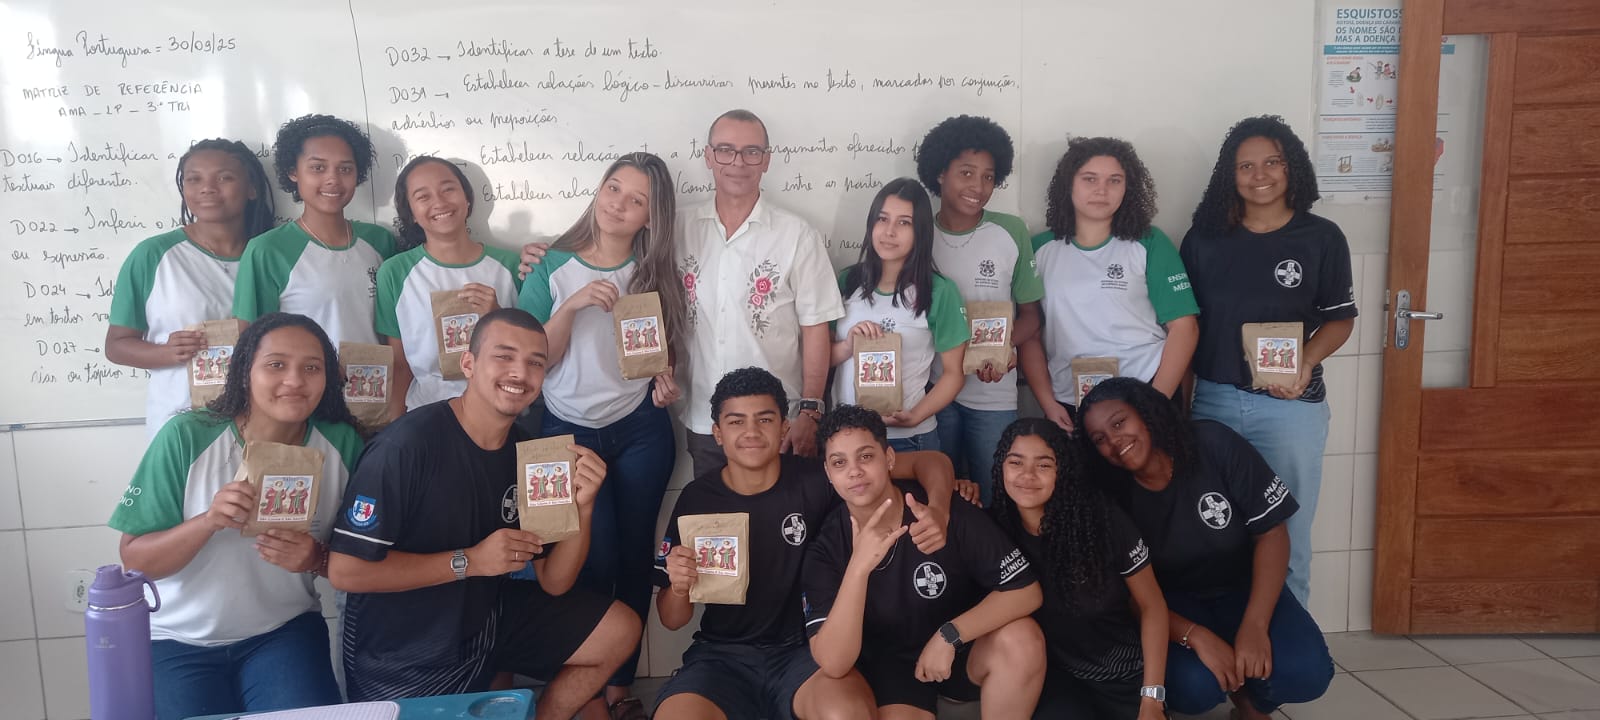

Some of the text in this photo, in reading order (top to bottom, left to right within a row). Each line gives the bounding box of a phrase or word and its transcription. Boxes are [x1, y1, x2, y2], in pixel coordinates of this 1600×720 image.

[1335, 26, 1347, 34] OS
[1349, 26, 1377, 34] NOMES
[1379, 25, 1396, 34] SÃO
[1335, 34, 1353, 42] MAS
[1354, 34, 1361, 42] A
[1363, 34, 1396, 43] DOENÇA
[76, 30, 153, 68] Portuguesa
[457, 37, 534, 63] Identificar
[542, 47, 550, 57] a
[554, 37, 576, 57] tese
[584, 40, 597, 57] de
[601, 47, 622, 57] um
[463, 69, 531, 92] Estabelecer
[748, 72, 797, 95] presentes
[803, 80, 820, 89] no
[938, 73, 956, 89] por
[22, 85, 69, 101] MATRIZ
[84, 84, 101, 97] DE
[58, 106, 88, 117] AMA
[465, 116, 483, 126] ou
[0, 149, 43, 167] D016
[68, 141, 159, 167] Identificar
[480, 141, 553, 165] Estabelecer
[482, 179, 553, 201] Estabelecer
[782, 173, 813, 192] entre
